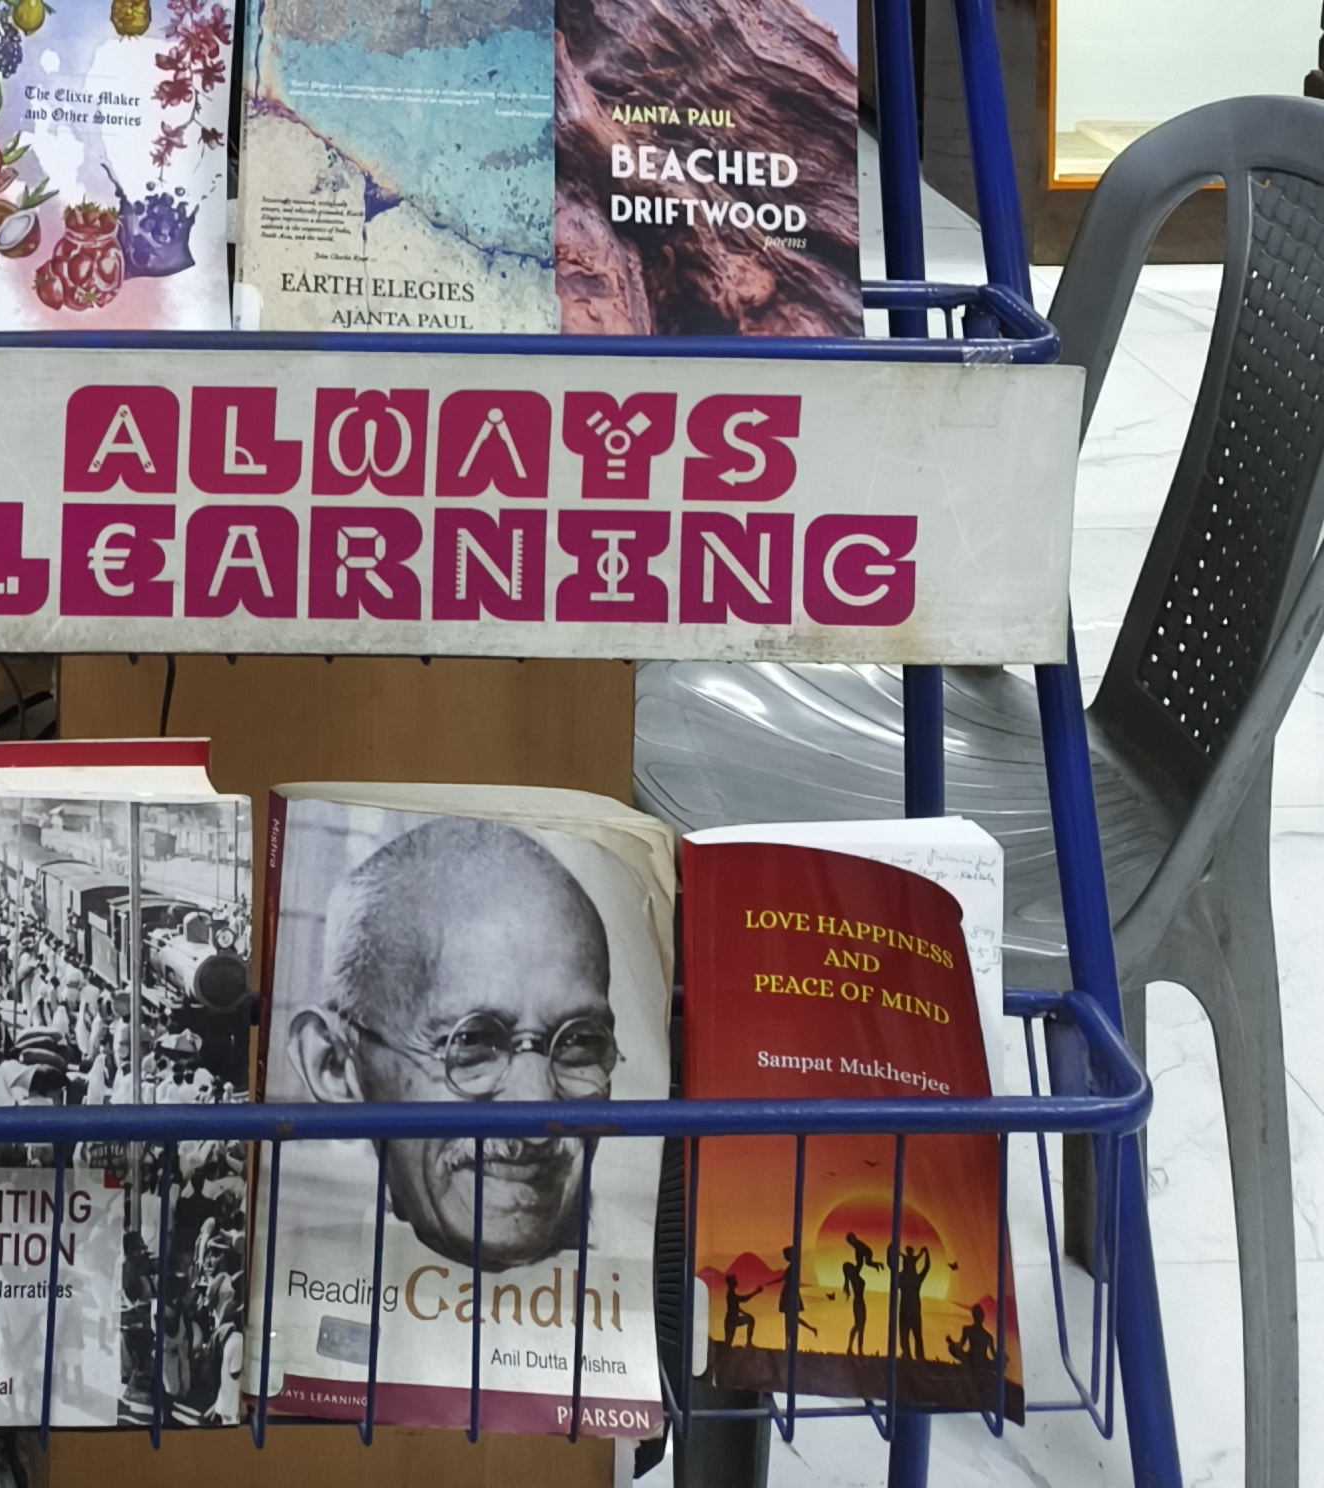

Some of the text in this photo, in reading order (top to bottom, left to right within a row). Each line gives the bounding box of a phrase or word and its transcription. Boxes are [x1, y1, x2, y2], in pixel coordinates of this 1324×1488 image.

[25, 86, 141, 107] The Elixir Maker
[24, 108, 142, 127] and Other Stories
[611, 105, 736, 128] AJANTA PAUL
[610, 143, 798, 188] BEACHED
[610, 194, 807, 233] DRIFTWOOD
[763, 234, 808, 251] poems
[281, 272, 475, 303] EARTH ELEGIES
[331, 309, 474, 330] AJANTA PAUL
[63, 385, 801, 502] ALWAYS
[269, 818, 280, 869] Mishra
[745, 910, 810, 933] LOVE
[816, 915, 954, 970] HAPPINESS
[823, 948, 881, 974] AND
[754, 974, 951, 1025] PEACE OF MIND
[757, 1050, 951, 1096] Sampat Mukherjee
[404, 1265, 624, 1333] Gandhi
[490, 1348, 521, 1368] Anil
[526, 1351, 568, 1371] Dutta
[557, 1405, 651, 1430] PARSON
